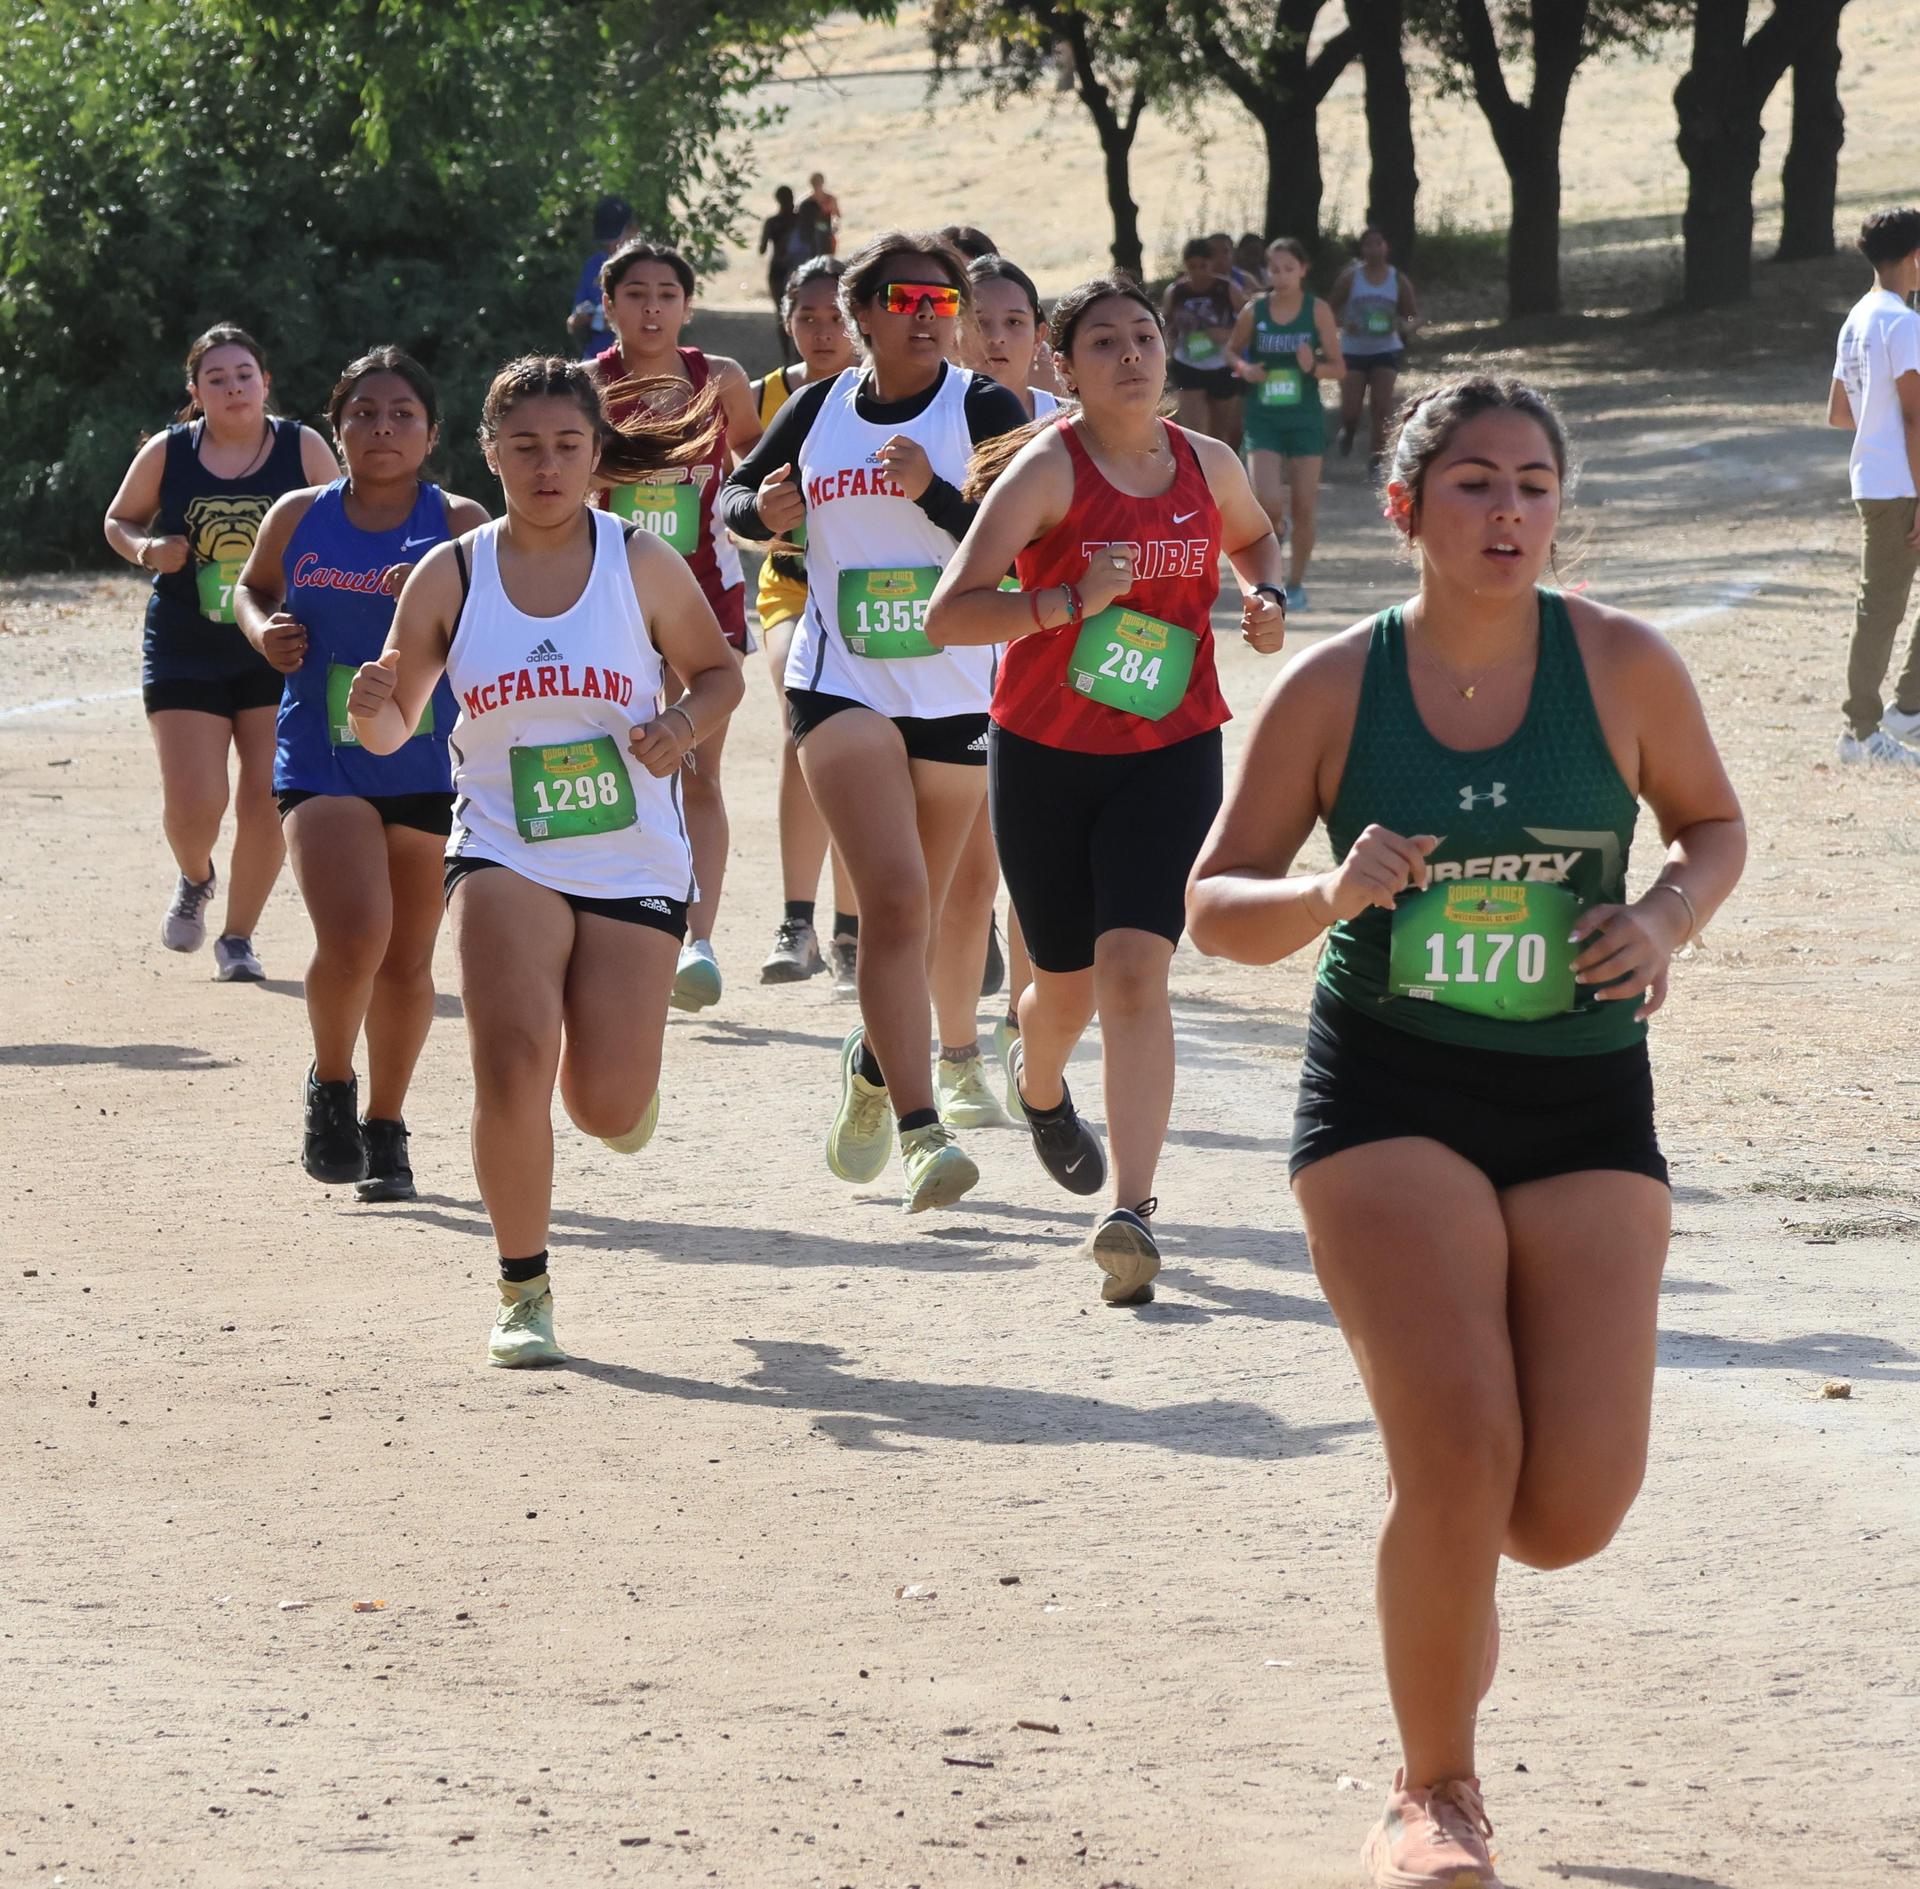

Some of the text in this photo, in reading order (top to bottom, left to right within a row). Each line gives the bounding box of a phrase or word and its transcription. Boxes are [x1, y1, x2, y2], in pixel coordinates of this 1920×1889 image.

[632, 509, 677, 536] 800
[856, 600, 929, 633] 1355
[526, 650, 563, 663] adidas
[1099, 642, 1162, 691] 284
[533, 771, 619, 814] 1298
[1408, 851, 1583, 888] IBERTY
[639, 899, 671, 915] adidas
[1448, 885, 1526, 903] ROUGH RIDER
[1425, 933, 1546, 983] 1170
